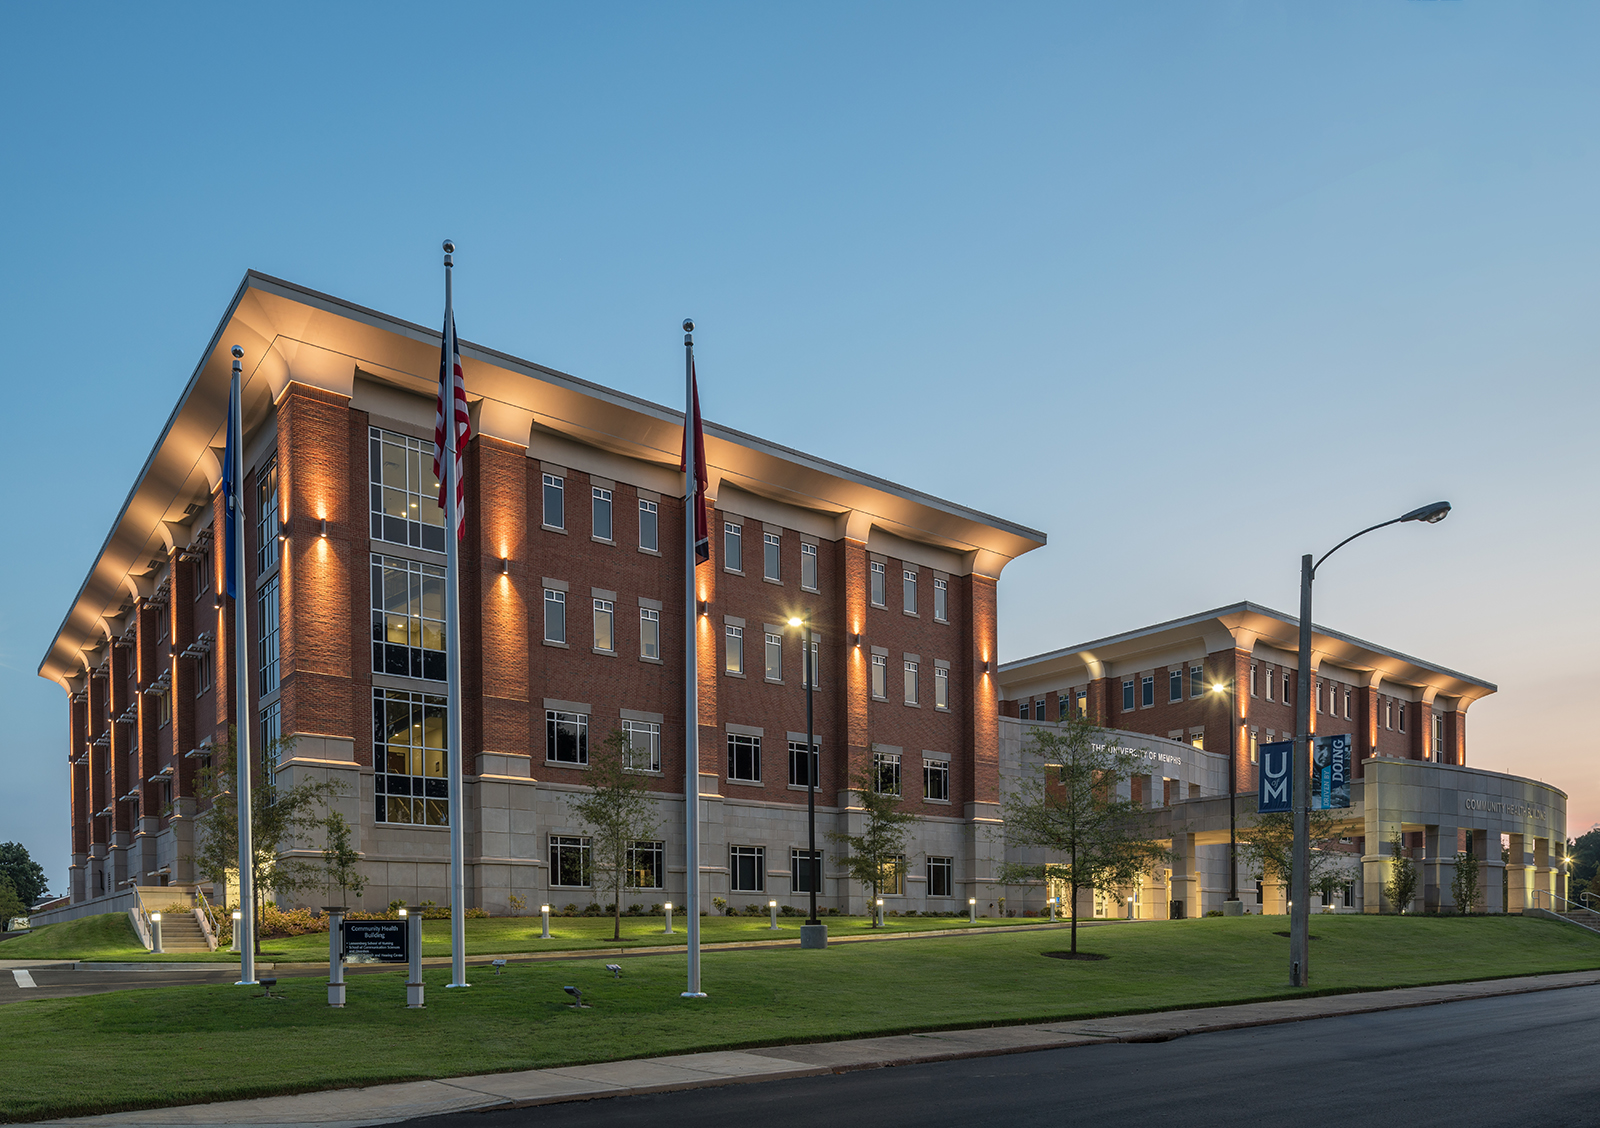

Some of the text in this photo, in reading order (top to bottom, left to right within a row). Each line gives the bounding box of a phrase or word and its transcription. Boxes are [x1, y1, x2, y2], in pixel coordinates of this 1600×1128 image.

[1091, 743, 1182, 766] THE UNIVERSTY OF MEMPHIS
[1265, 751, 1288, 778] U
[1332, 739, 1344, 782] DOING
[1323, 770, 1330, 780] BY
[1263, 776, 1288, 804] M
[1465, 798, 1547, 821] COMMUNITY HEALTH BUILDING
